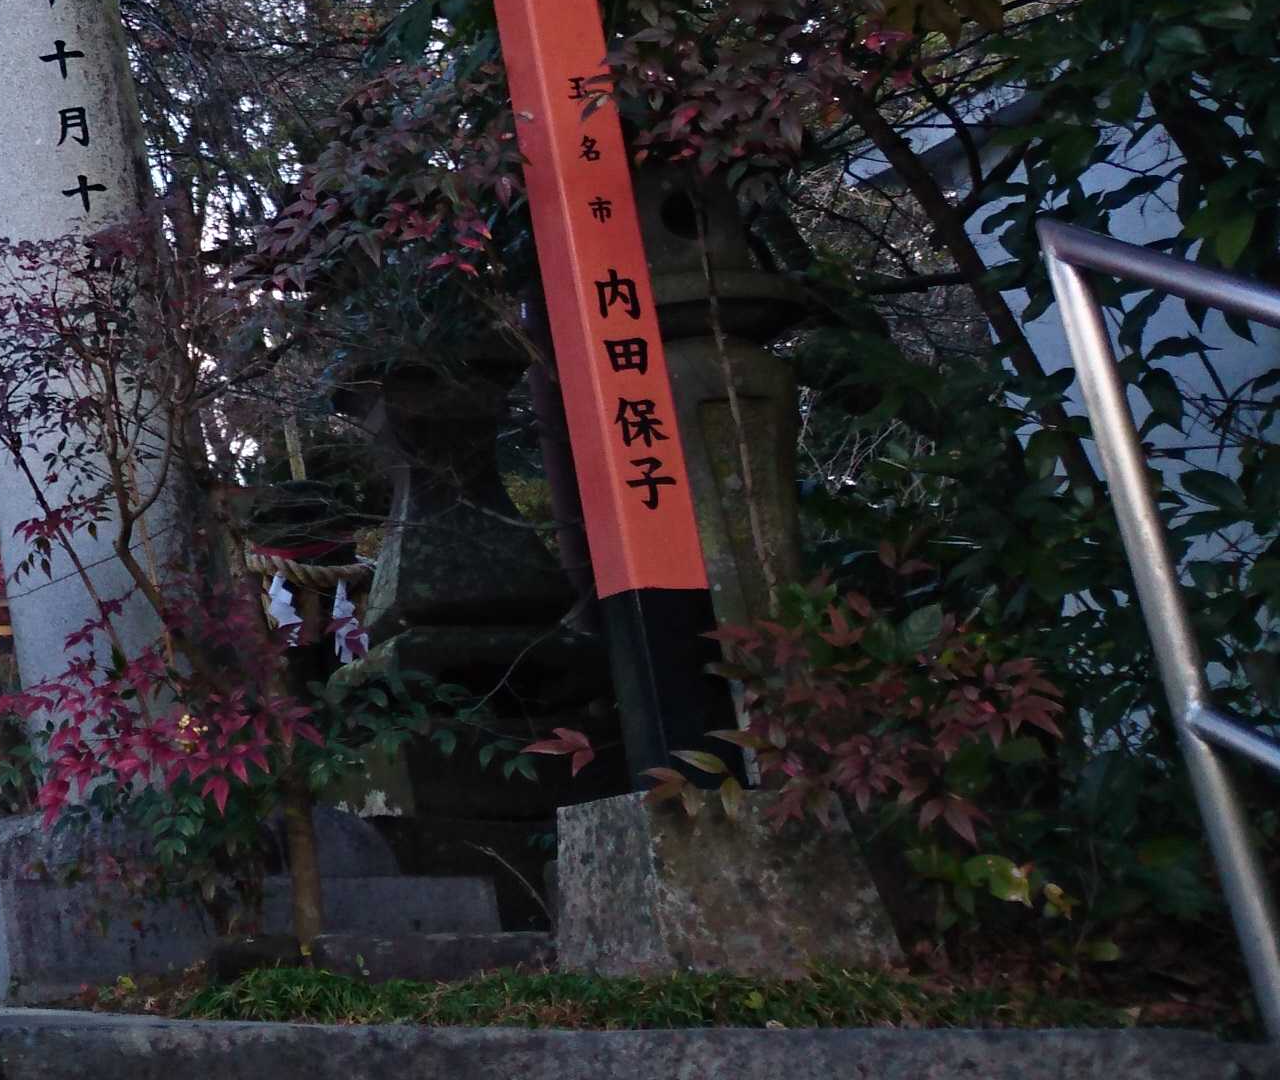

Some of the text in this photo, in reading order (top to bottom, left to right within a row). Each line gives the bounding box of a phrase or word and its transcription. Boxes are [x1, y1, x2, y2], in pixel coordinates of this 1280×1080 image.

[568, 75, 614, 224] 玉名市
[595, 268, 677, 510] 内田保子
